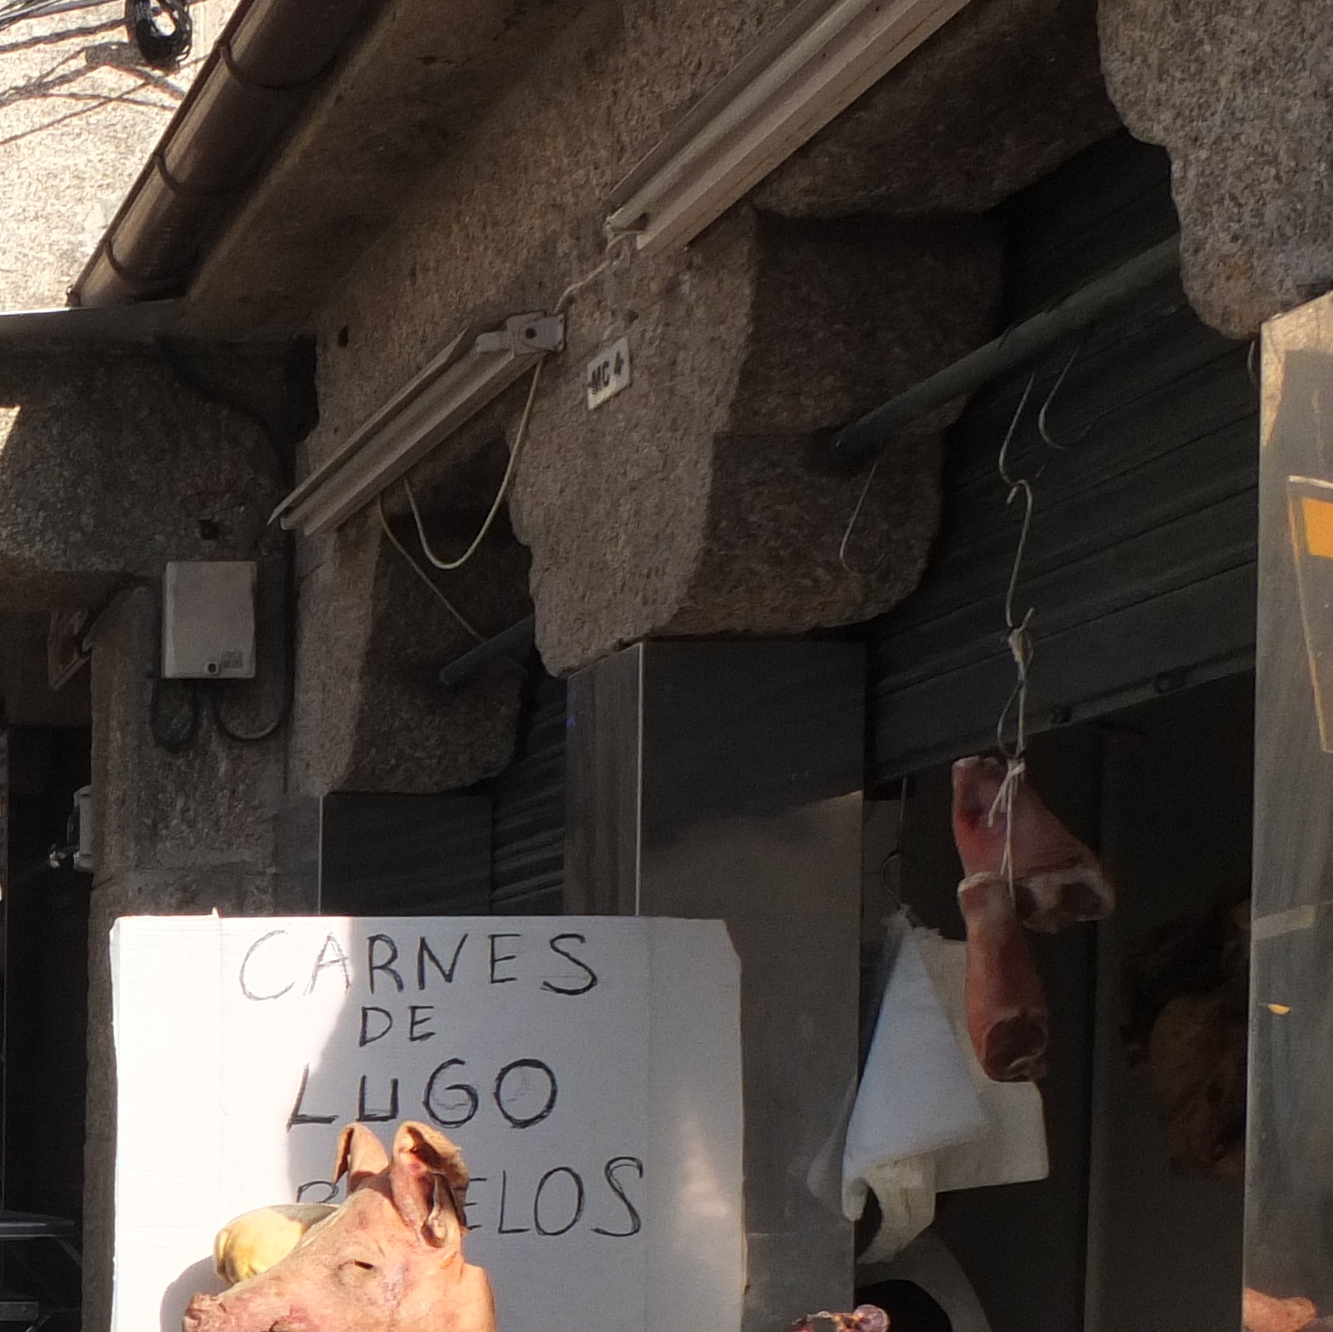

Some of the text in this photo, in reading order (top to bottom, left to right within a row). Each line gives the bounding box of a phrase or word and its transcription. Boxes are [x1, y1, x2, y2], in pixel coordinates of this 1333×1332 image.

[239, 929, 598, 1001] CARNES
[358, 1005, 436, 1048] DE
[285, 1057, 559, 1132] LUGO
